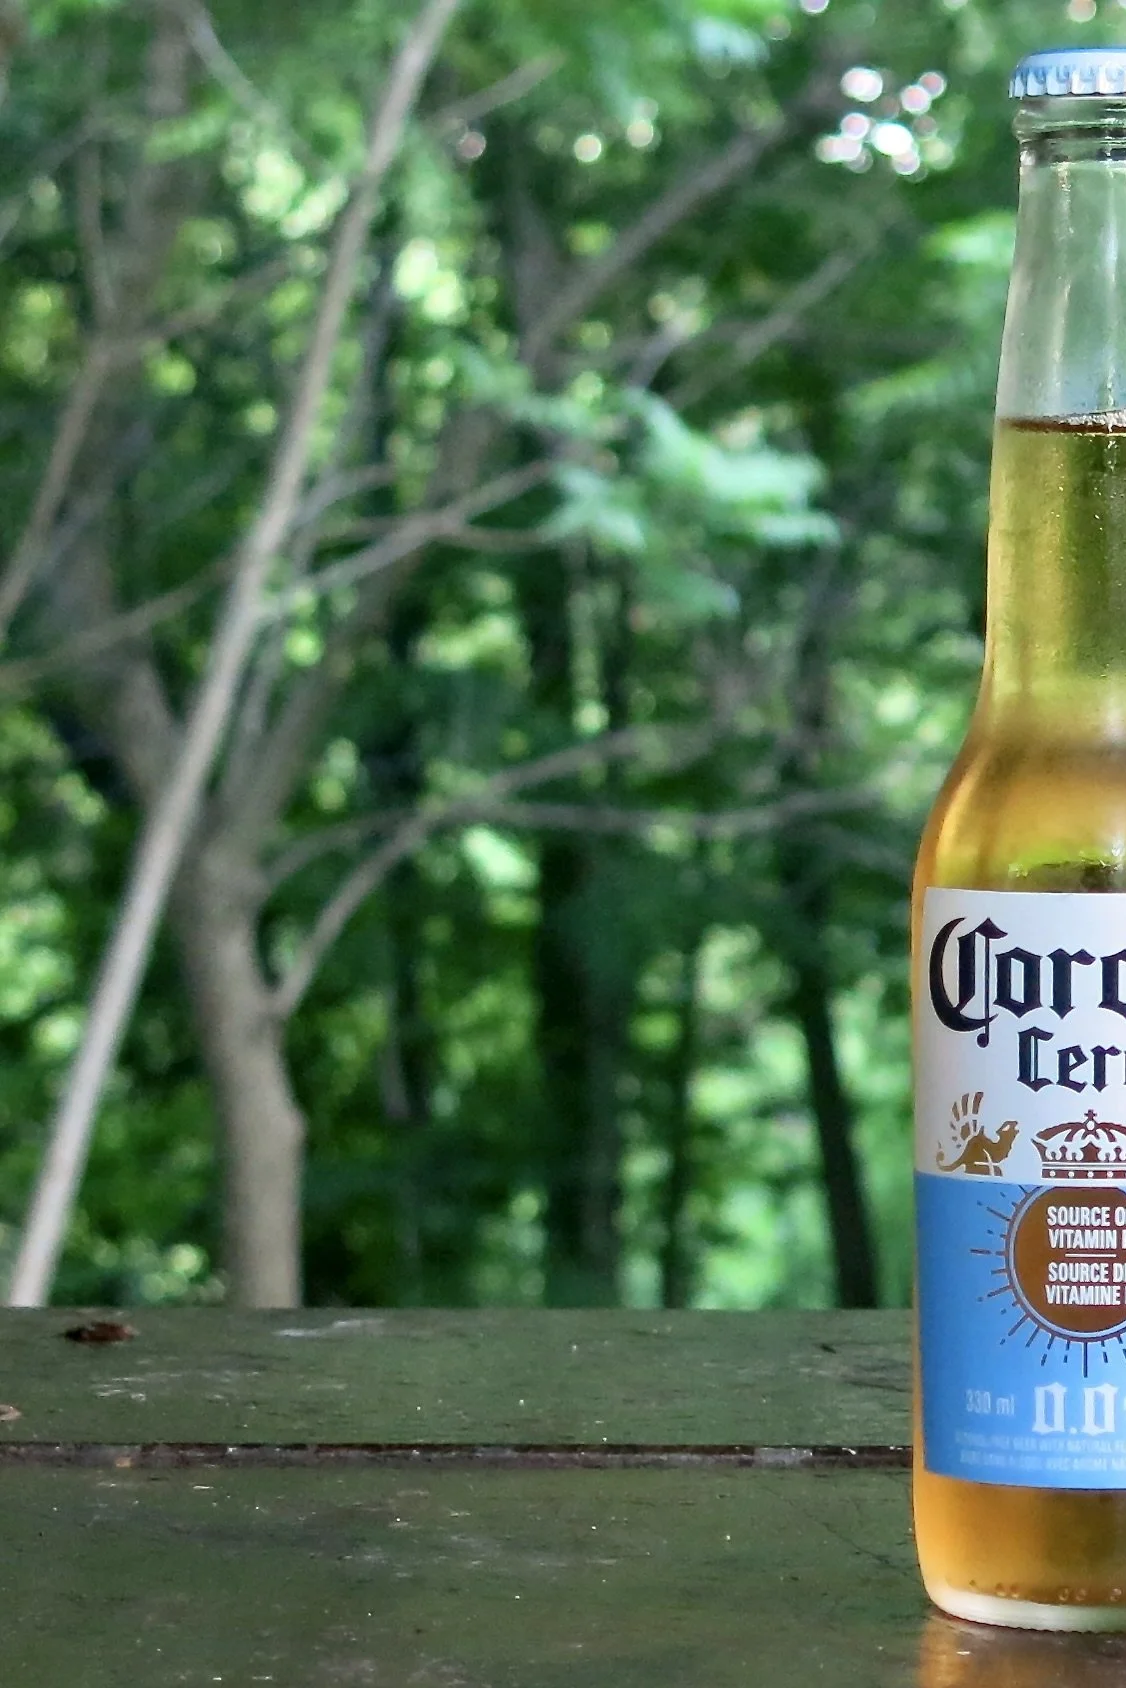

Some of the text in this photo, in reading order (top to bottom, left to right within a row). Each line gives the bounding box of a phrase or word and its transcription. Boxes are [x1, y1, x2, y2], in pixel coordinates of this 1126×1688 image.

[1046, 1206, 1110, 1227] SOURCE
[1048, 1229, 1118, 1250] VITAMIN
[1047, 1262, 1109, 1283] SOURCE
[1044, 1284, 1121, 1306] VITAMINE
[965, 1388, 992, 1415] 330
[995, 1395, 1016, 1416] ml
